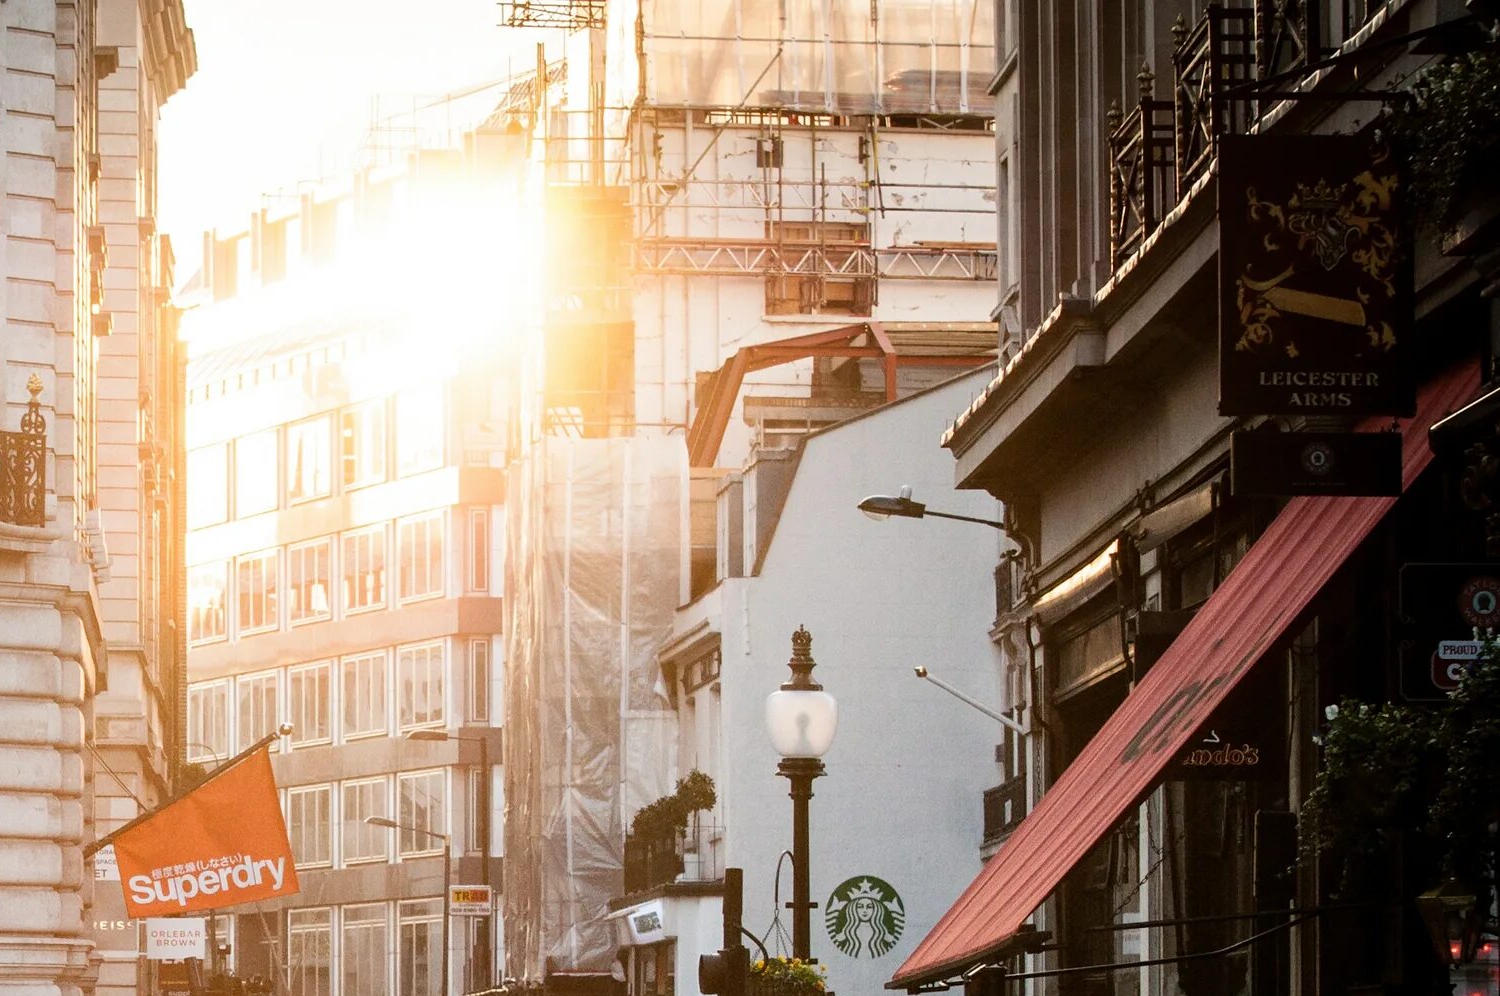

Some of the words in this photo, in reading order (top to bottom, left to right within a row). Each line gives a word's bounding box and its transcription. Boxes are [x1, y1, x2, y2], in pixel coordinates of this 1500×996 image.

[1259, 371, 1380, 387] LEICESTER
[1288, 392, 1352, 407] ARMS
[1442, 645, 1478, 655] PROUD
[1181, 742, 1260, 767] ndo's
[128, 855, 285, 907] Superdry
[150, 930, 202, 938] ORLEBAR
[156, 938, 197, 947] BROWN
